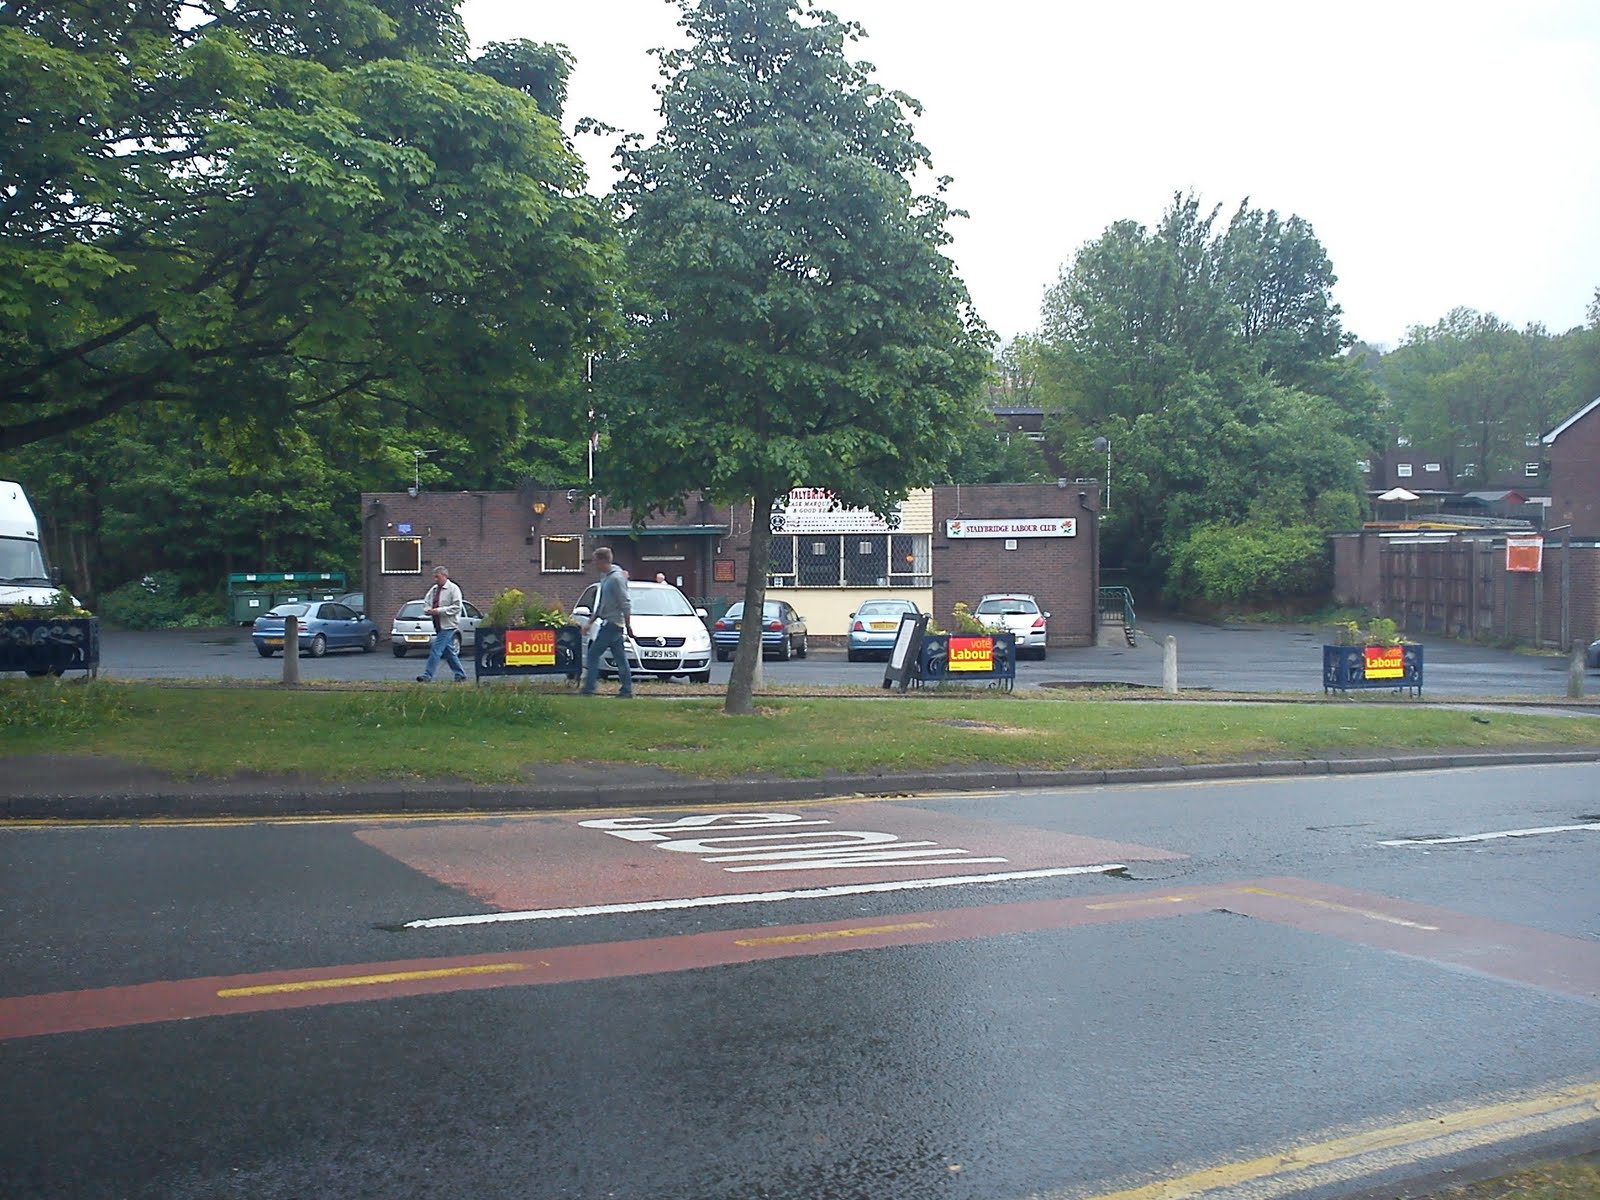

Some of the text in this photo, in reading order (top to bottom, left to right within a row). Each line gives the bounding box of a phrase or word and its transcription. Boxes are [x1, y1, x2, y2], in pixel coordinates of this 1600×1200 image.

[966, 525, 1009, 533] STALYBRIDGE
[1039, 524, 1057, 532] CLUB
[531, 632, 554, 641] vote
[508, 641, 554, 653] Labour
[971, 640, 991, 648] vote
[951, 648, 991, 659] Labour
[1366, 657, 1401, 667] Labour
